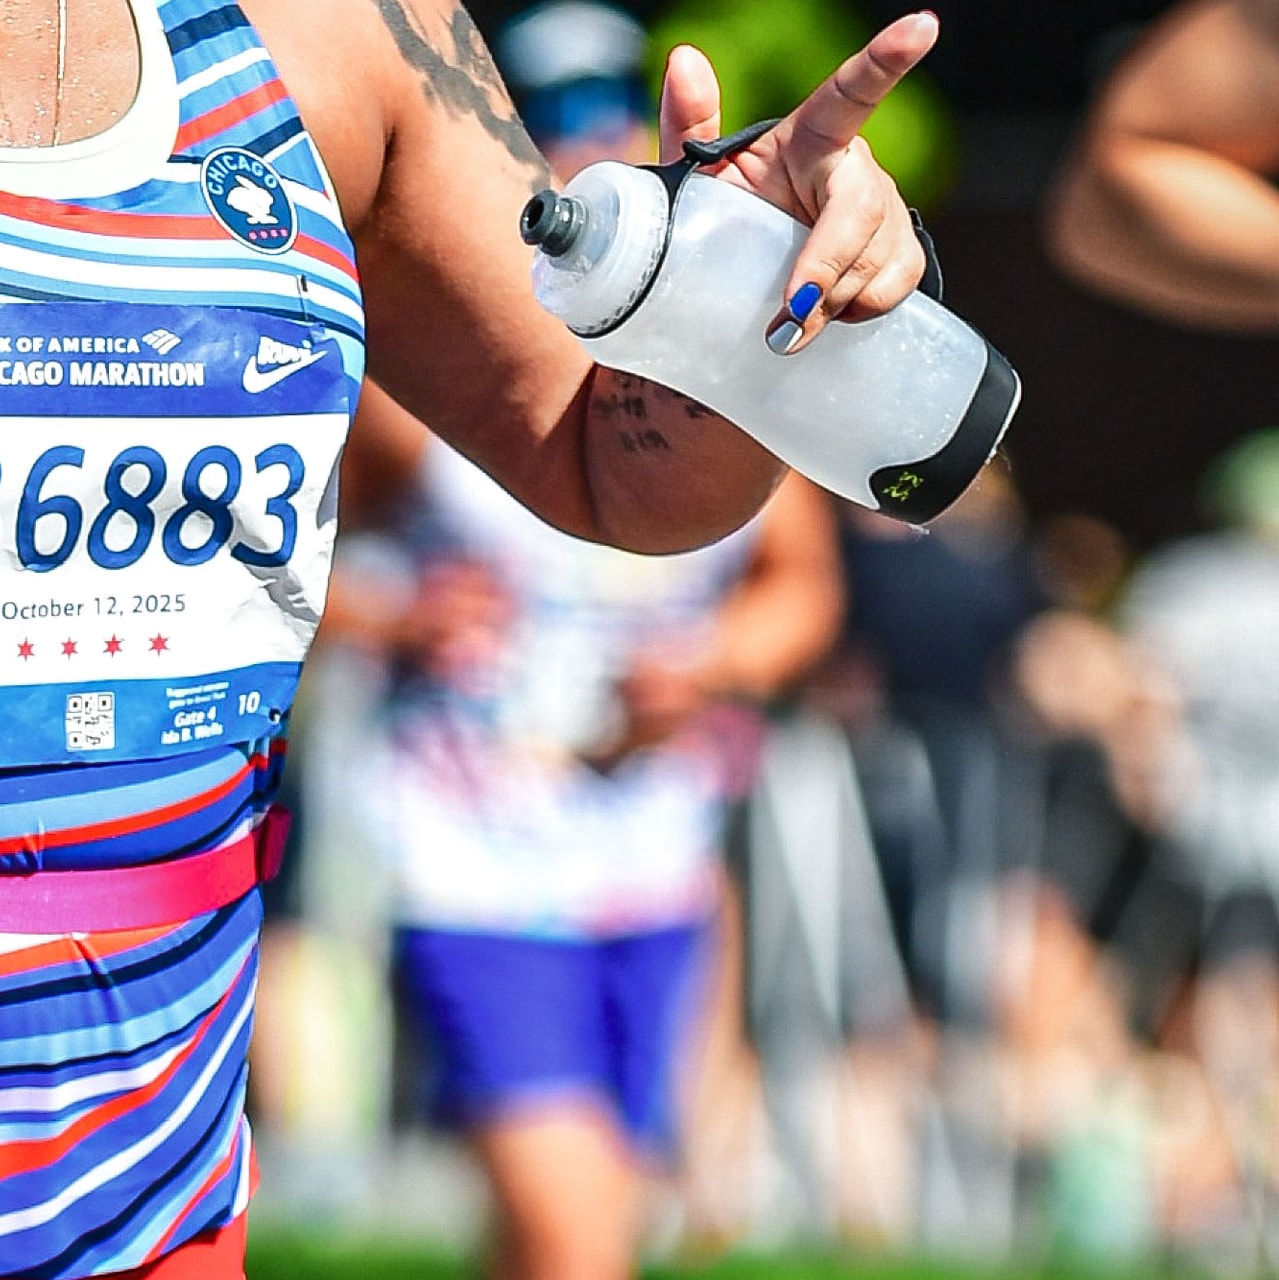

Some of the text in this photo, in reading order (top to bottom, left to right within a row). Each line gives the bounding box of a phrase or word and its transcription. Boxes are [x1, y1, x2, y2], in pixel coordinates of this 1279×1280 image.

[207, 154, 278, 196] CHICAGO
[15, 336, 45, 354] OF
[47, 336, 141, 355] AMERICA
[69, 360, 206, 388] MARATHON
[1, 593, 186, 620] October 12, 2025
[238, 690, 261, 717] 10
[173, 710, 206, 728] Gate
